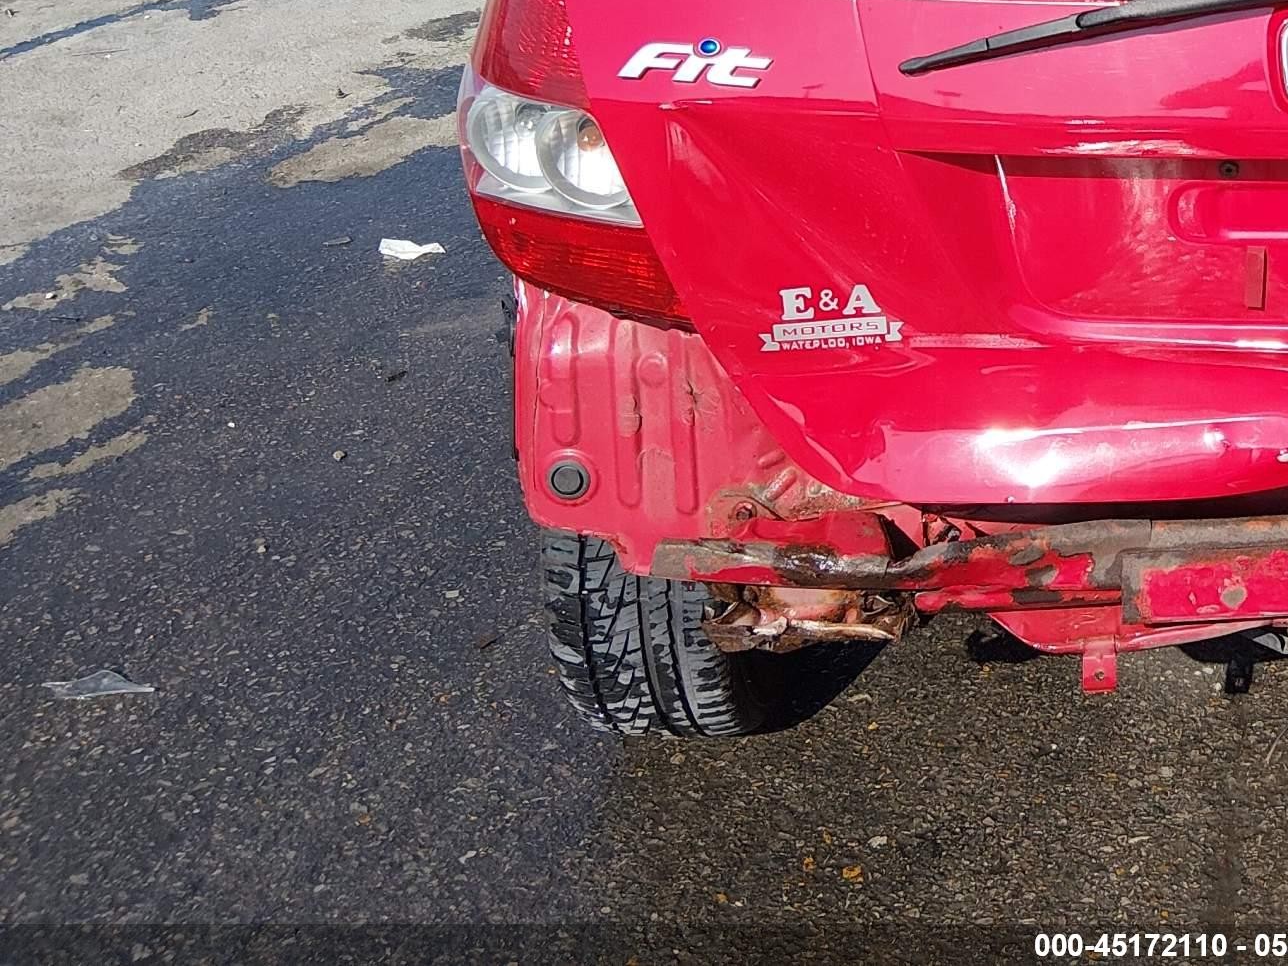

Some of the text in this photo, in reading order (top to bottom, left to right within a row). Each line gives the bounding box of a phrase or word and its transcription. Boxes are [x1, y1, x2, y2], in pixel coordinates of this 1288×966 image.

[616, 37, 774, 89] Fit
[779, 283, 883, 321] E & A
[782, 321, 879, 337] MOTORS
[781, 336, 883, 351] WATERLOO, IOWA
